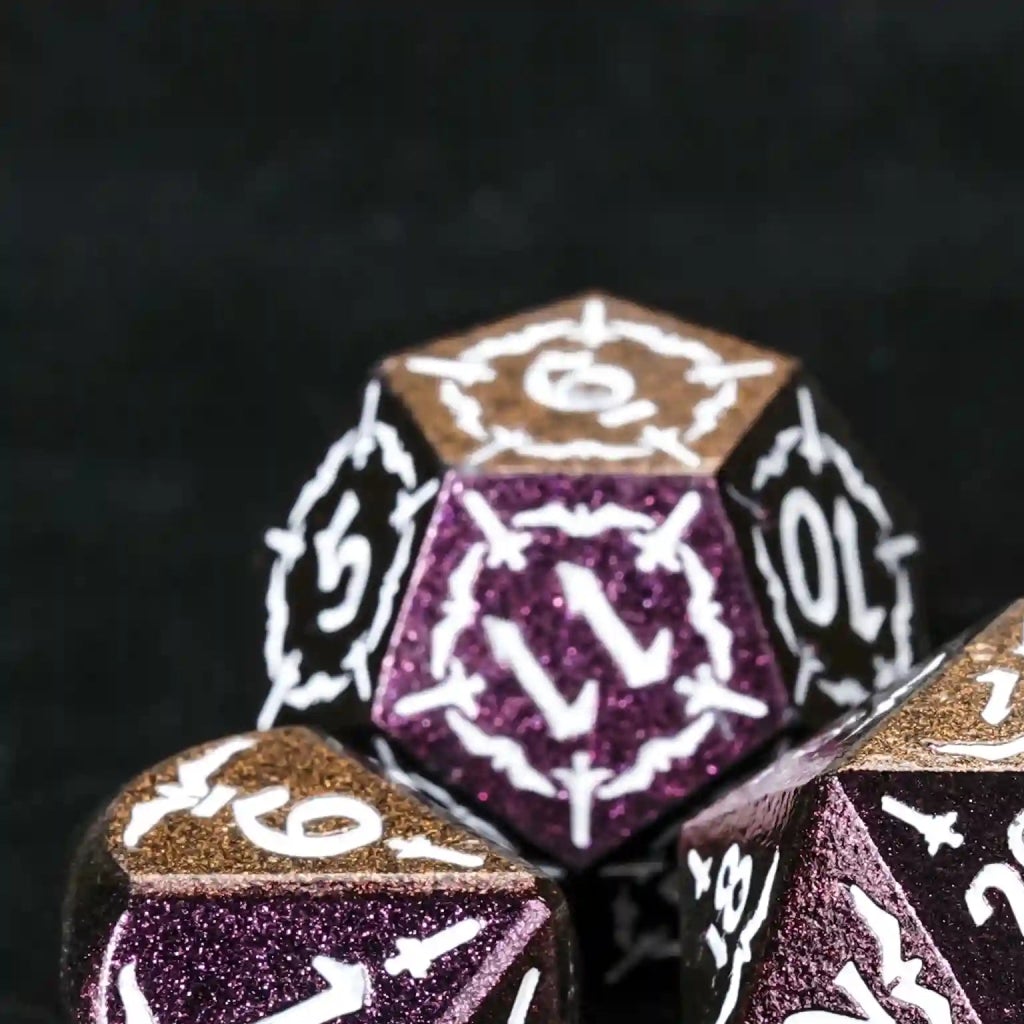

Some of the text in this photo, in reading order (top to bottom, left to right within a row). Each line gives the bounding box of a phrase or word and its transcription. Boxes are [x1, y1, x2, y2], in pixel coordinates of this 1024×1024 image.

[313, 490, 372, 634] 5
[779, 487, 885, 642] 10
[482, 560, 673, 742] 11
